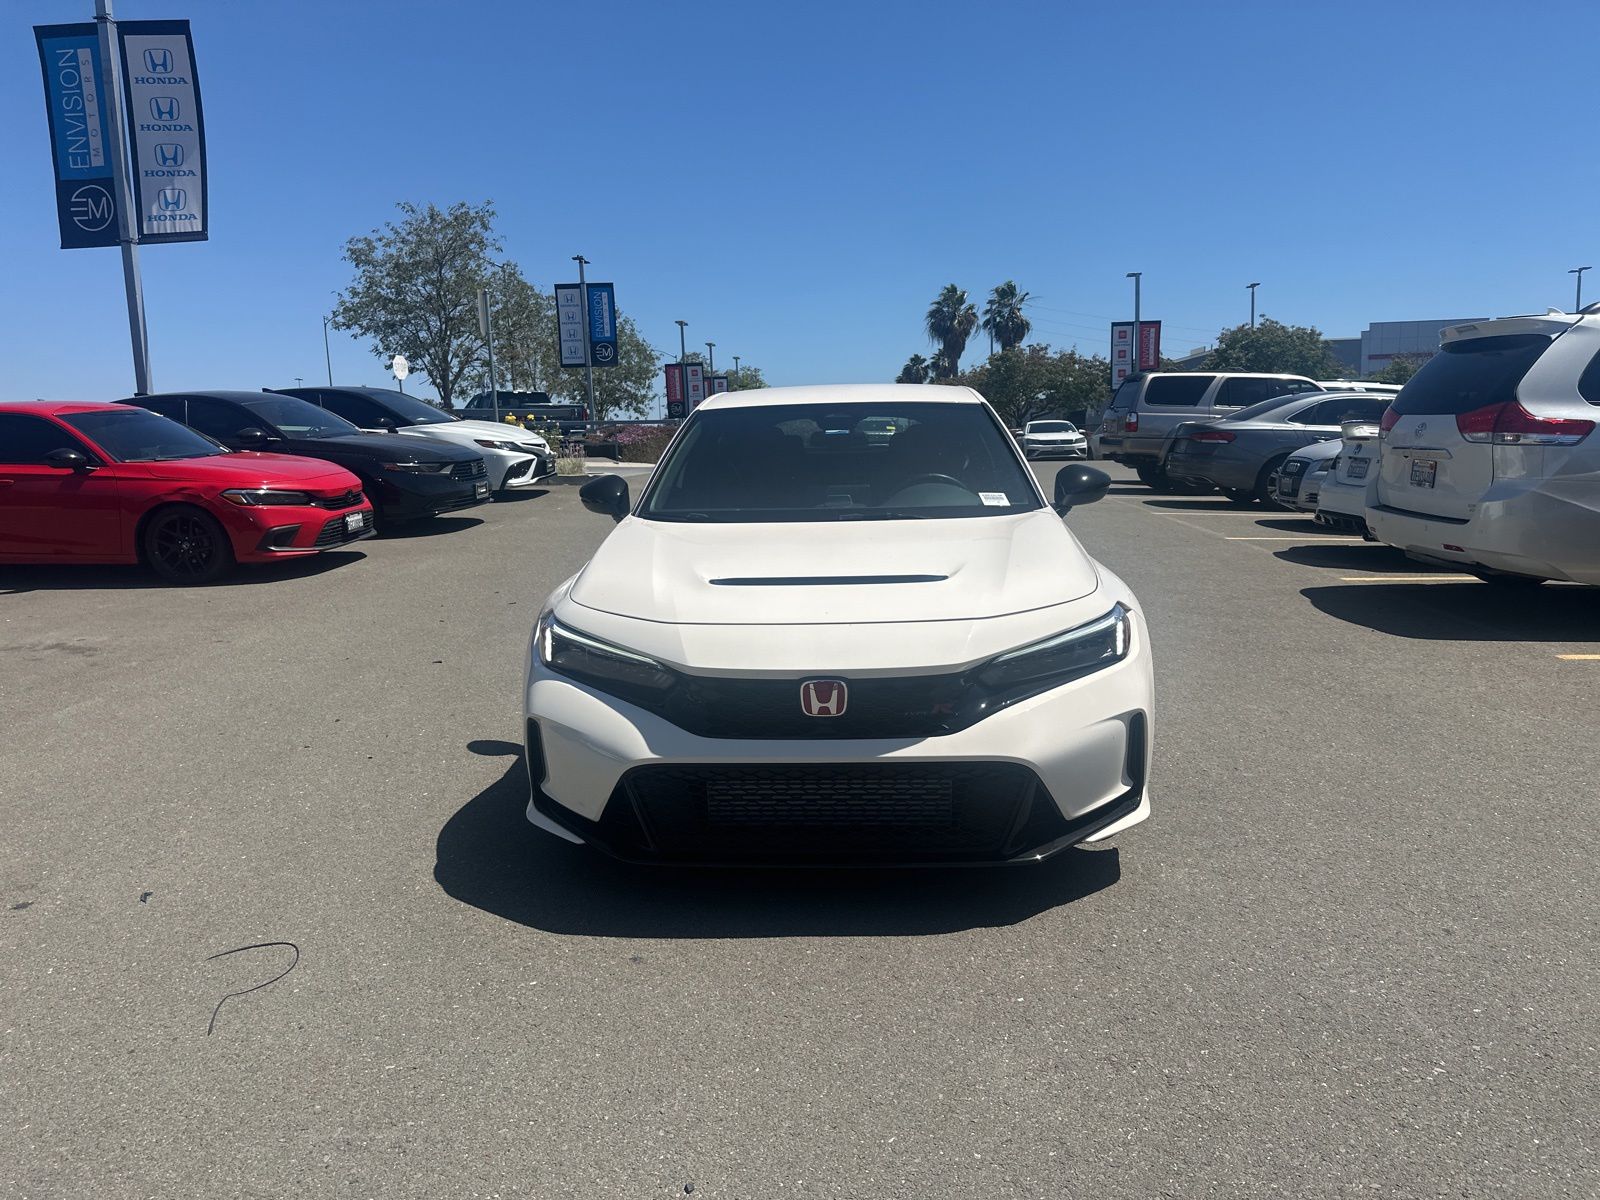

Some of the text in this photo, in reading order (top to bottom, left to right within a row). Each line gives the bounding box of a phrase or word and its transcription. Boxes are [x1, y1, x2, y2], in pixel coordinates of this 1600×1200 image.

[134, 76, 188, 85] HONDA
[56, 49, 90, 169] ENVISION
[81, 59, 101, 158] MOTORS
[139, 124, 193, 132] HONDA
[144, 169, 197, 177] HONDA
[147, 213, 198, 222] HONDA
